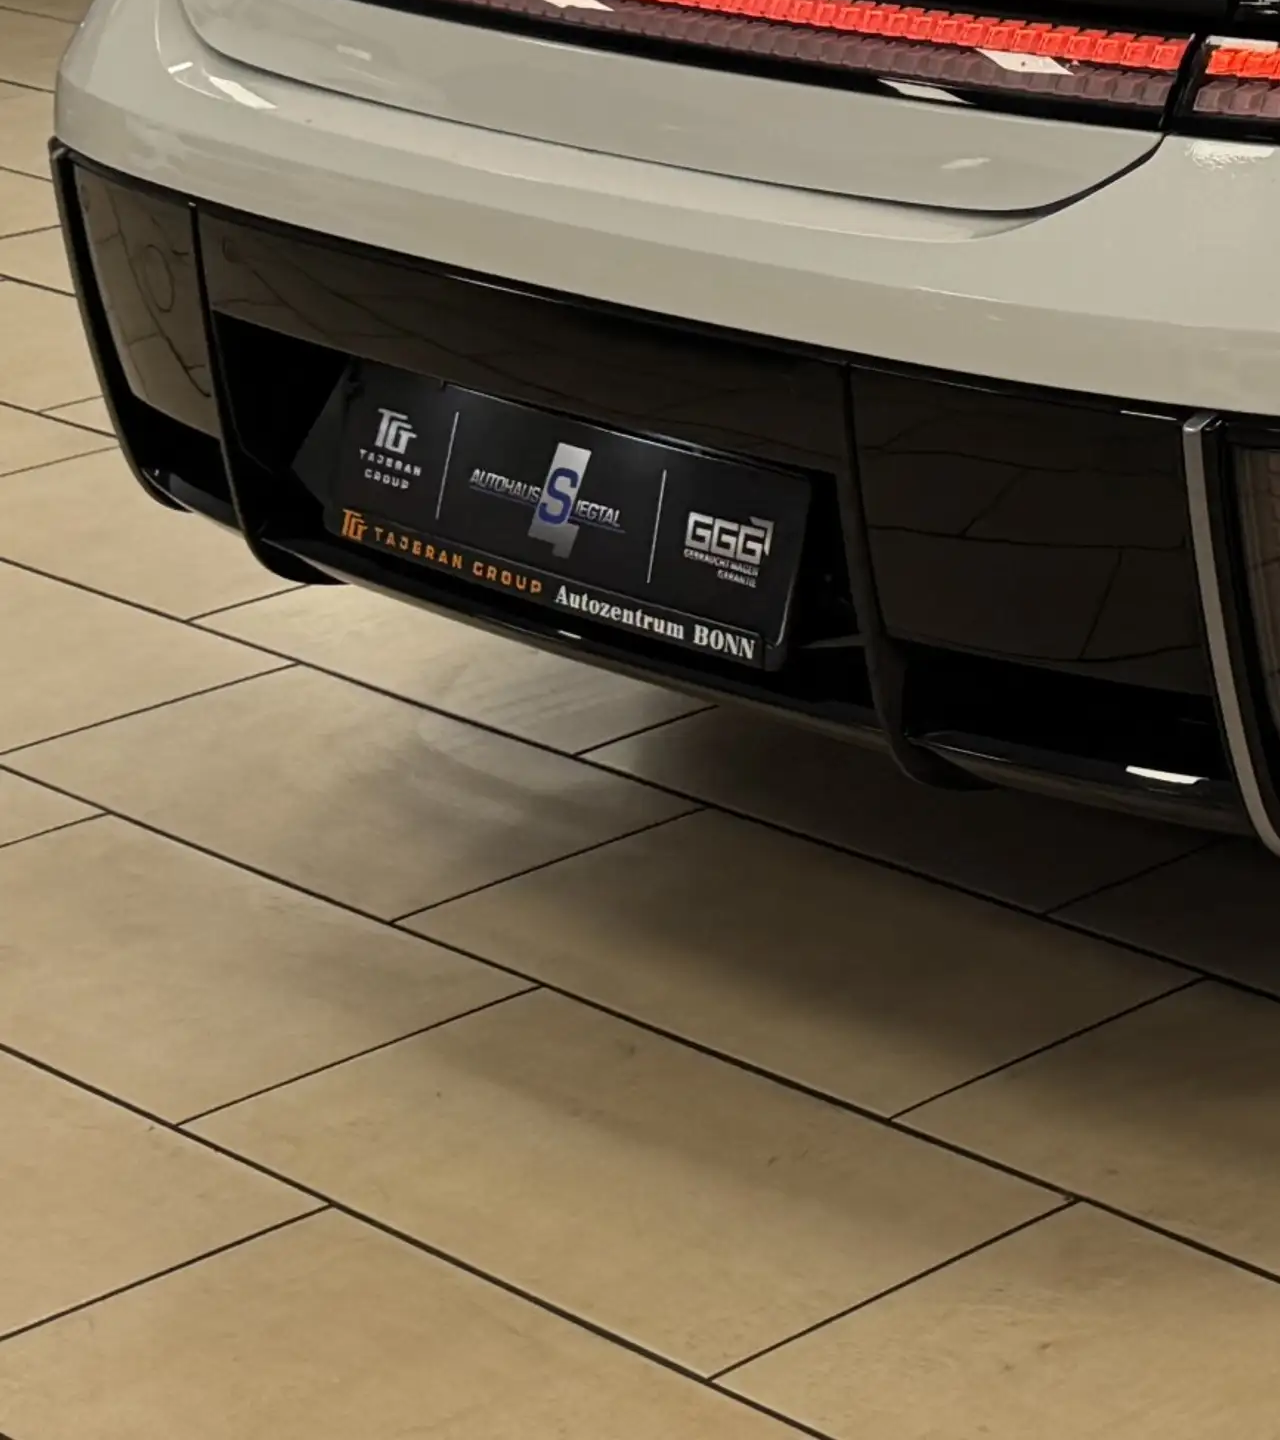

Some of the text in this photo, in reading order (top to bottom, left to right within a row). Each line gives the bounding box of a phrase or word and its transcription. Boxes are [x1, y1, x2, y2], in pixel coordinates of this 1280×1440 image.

[364, 468, 410, 490] GROUP
[469, 467, 542, 504] AUTOHAUS
[373, 526, 463, 570] TAJERAN
[472, 561, 543, 595] GROUP
[555, 585, 684, 640] Autozentrum
[692, 623, 755, 660] BONN
